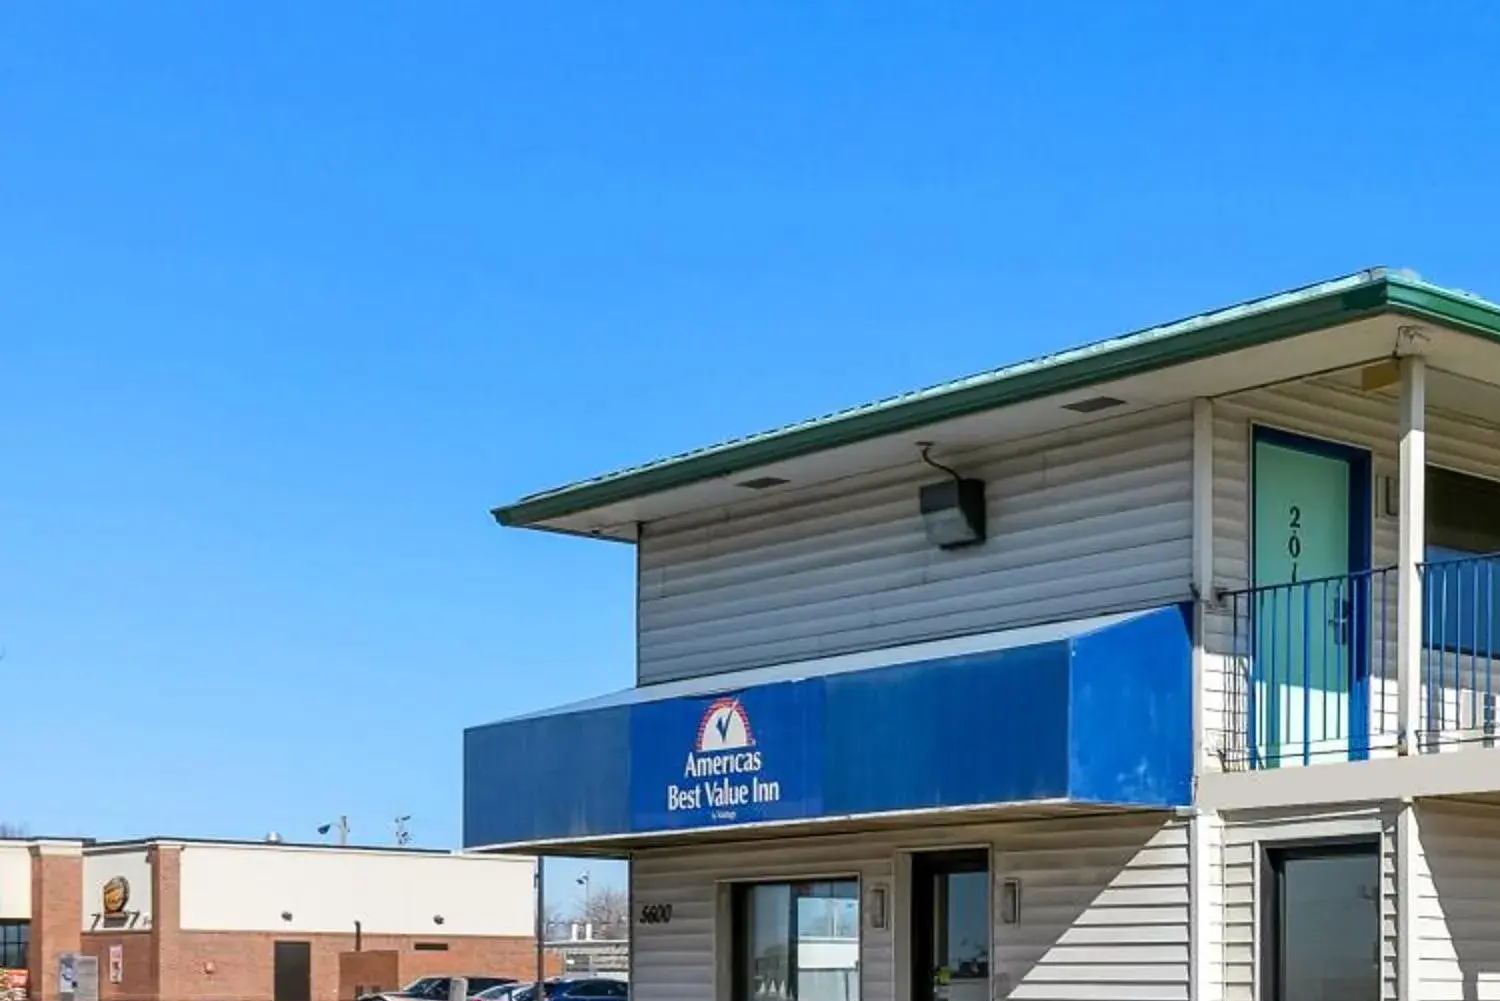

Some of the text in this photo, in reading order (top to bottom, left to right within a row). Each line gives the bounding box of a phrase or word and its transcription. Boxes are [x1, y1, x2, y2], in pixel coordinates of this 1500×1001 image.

[1289, 505, 1301, 583] 201
[685, 751, 762, 778] Americas
[667, 776, 780, 811] Best Value Inn
